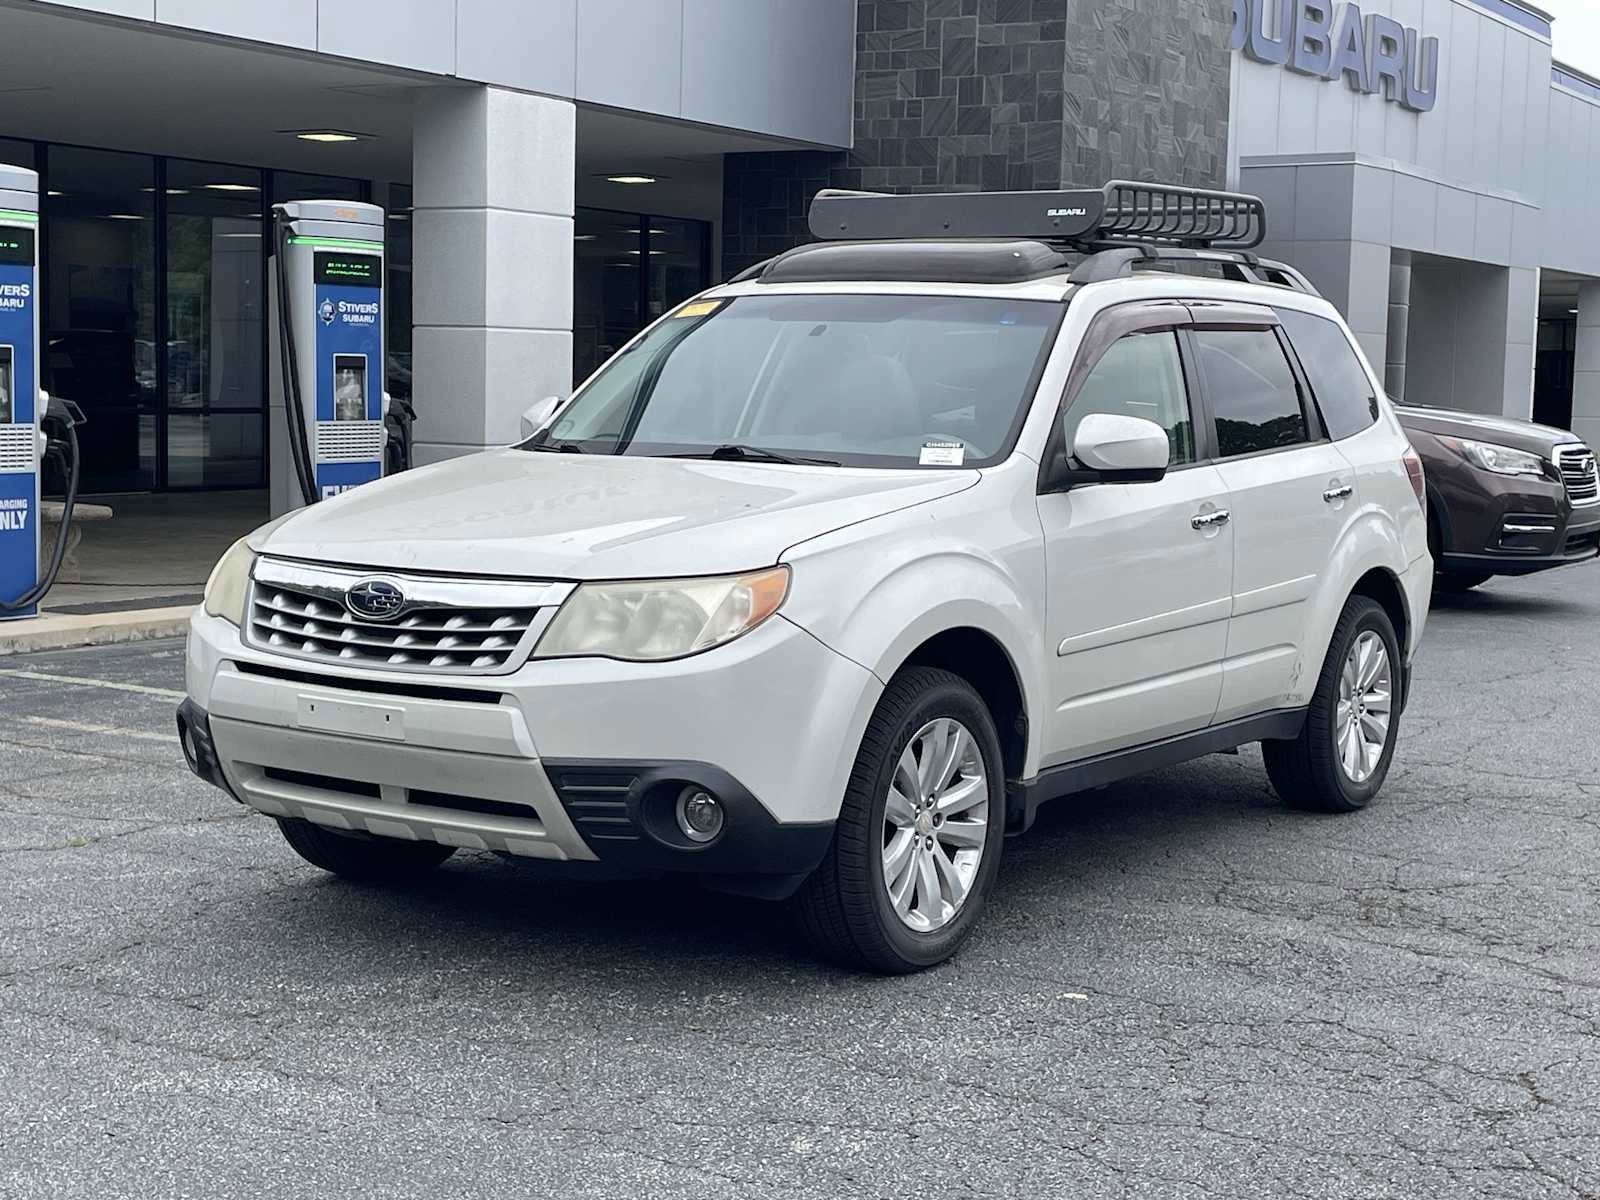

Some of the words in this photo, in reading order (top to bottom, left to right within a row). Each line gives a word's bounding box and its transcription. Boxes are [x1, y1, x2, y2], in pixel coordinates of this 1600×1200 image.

[1231, 0, 1439, 112] UBARU
[1047, 208, 1086, 216] SUBARU
[338, 301, 379, 313] STIVERS
[342, 314, 375, 323] SUBARU
